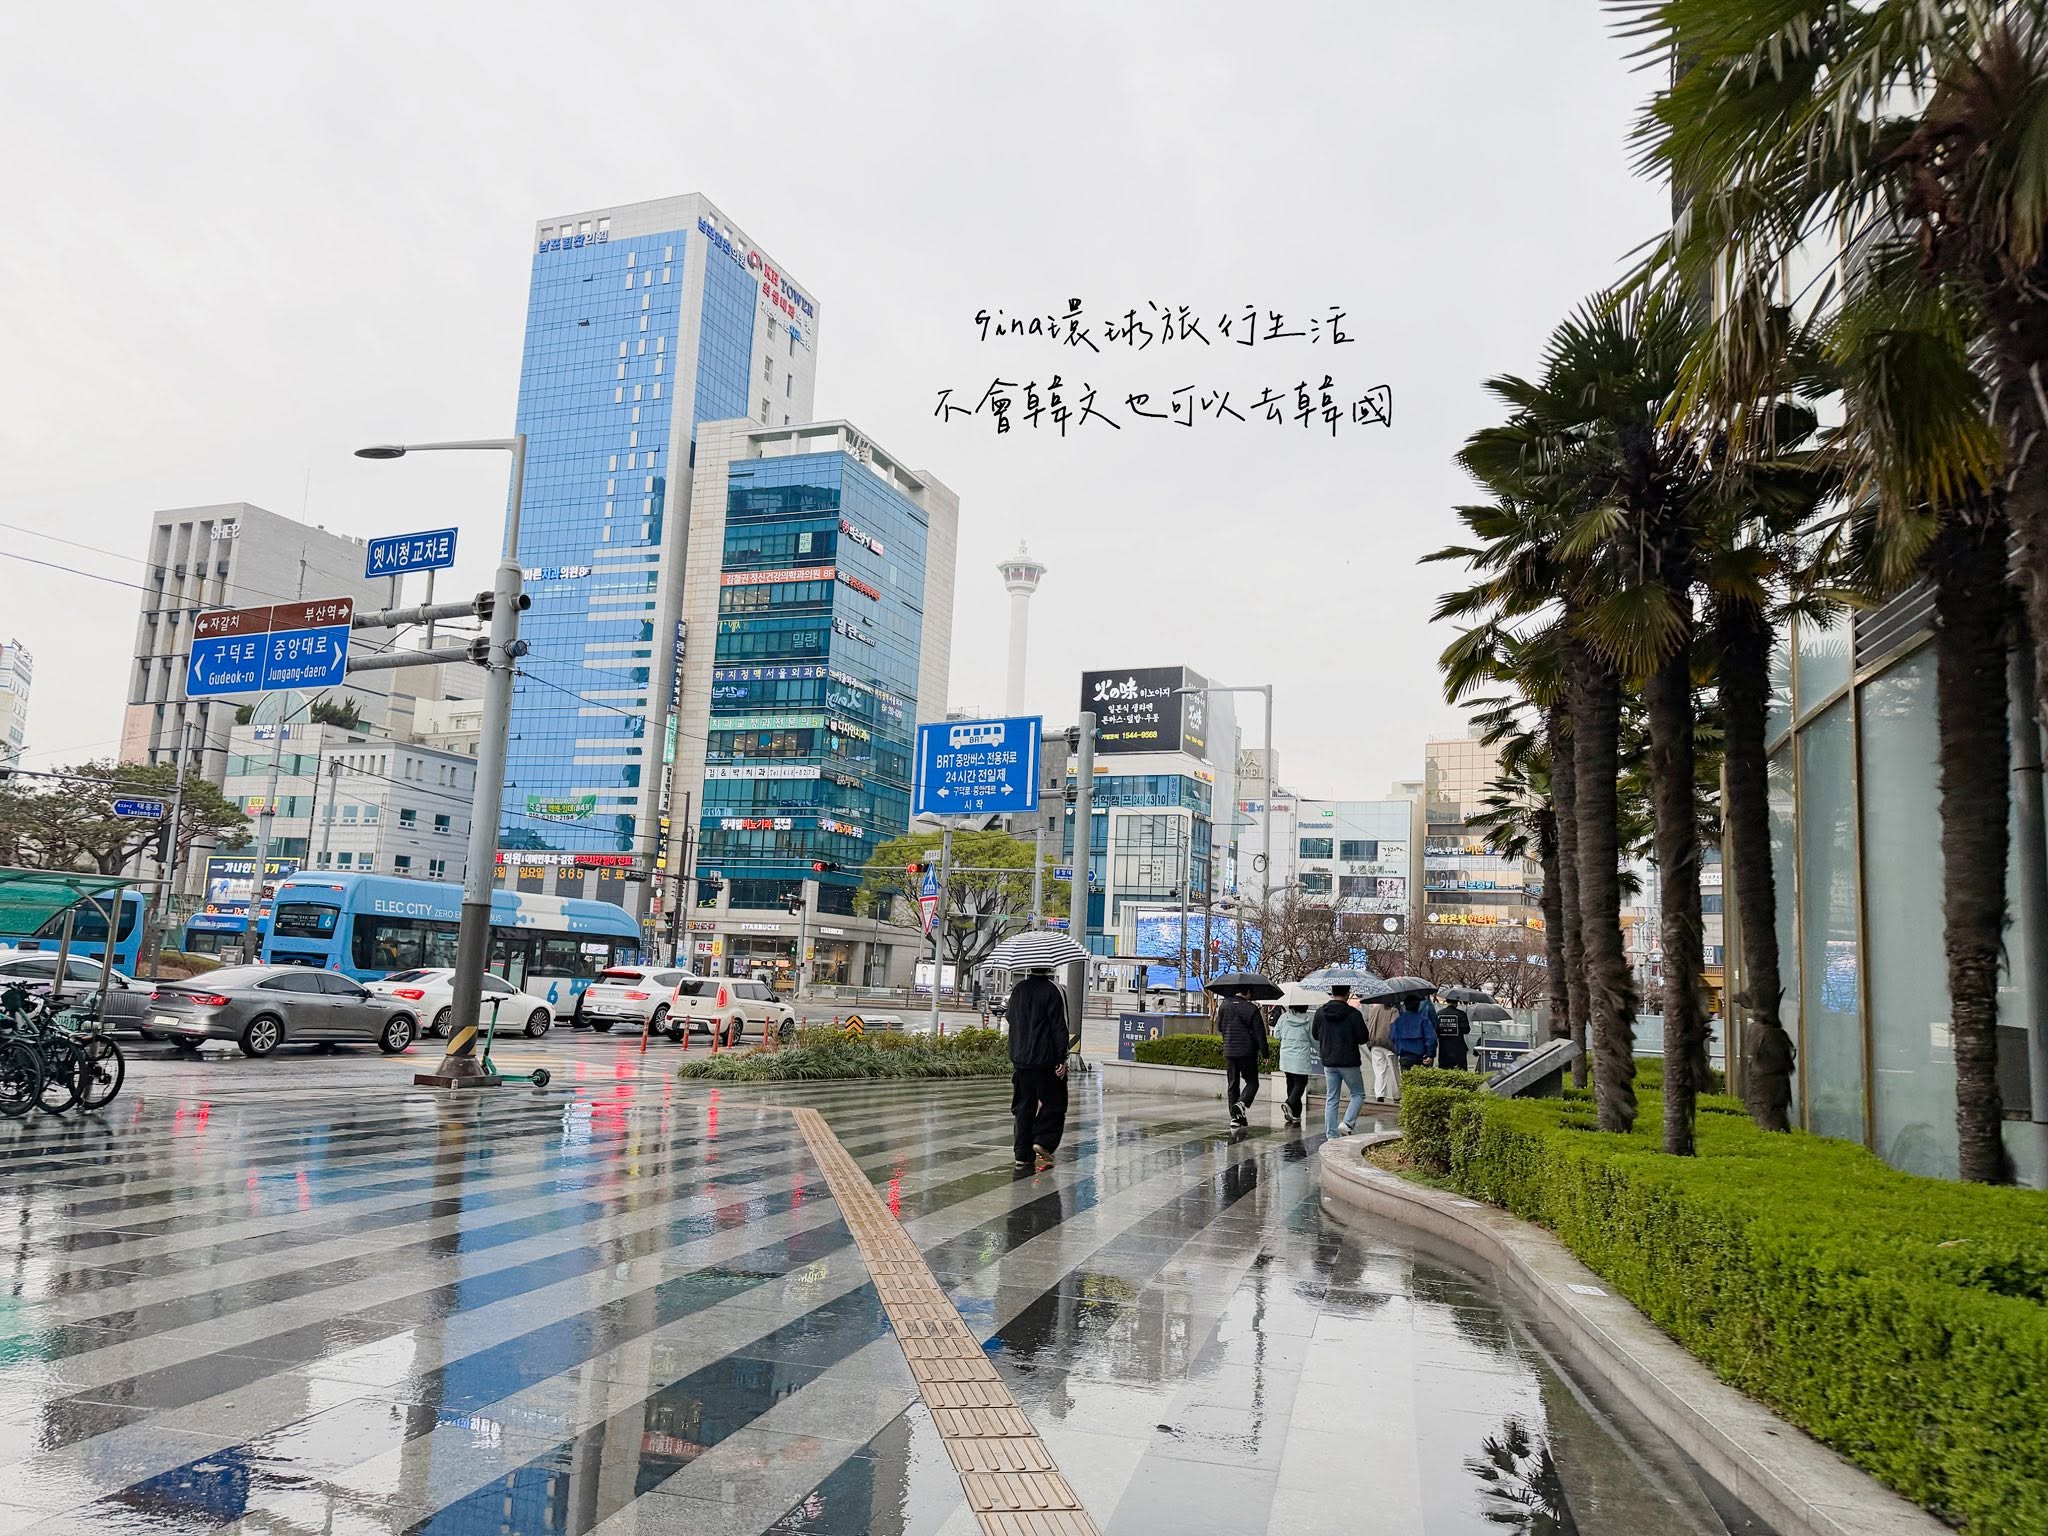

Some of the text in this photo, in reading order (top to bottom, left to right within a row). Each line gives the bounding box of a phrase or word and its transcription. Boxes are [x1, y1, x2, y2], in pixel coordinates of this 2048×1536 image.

[780, 278, 814, 318] TOWER
[304, 605, 337, 622] 부산역
[210, 615, 240, 632] 자갈치
[274, 636, 328, 661] 중앙대로
[793, 632, 817, 648] 밀란
[214, 643, 256, 664] 구덕로
[208, 672, 255, 686] Gudeok-ro
[267, 665, 327, 682] Jungang-daero
[1092, 676, 1171, 701] 火の味 히노아지
[969, 735, 984, 744] BRT
[936, 751, 1017, 769] BRT 중앙버스 전용차로
[978, 767, 1006, 782] 전일제
[559, 867, 584, 878] 365
[600, 868, 625, 880] 진료
[374, 899, 405, 914] ELEC
[406, 902, 432, 916] CITY
[434, 908, 454, 917] ZERO
[323, 917, 331, 928] 6
[547, 981, 559, 1005] 6
[1124, 1020, 1146, 1032] 남포
